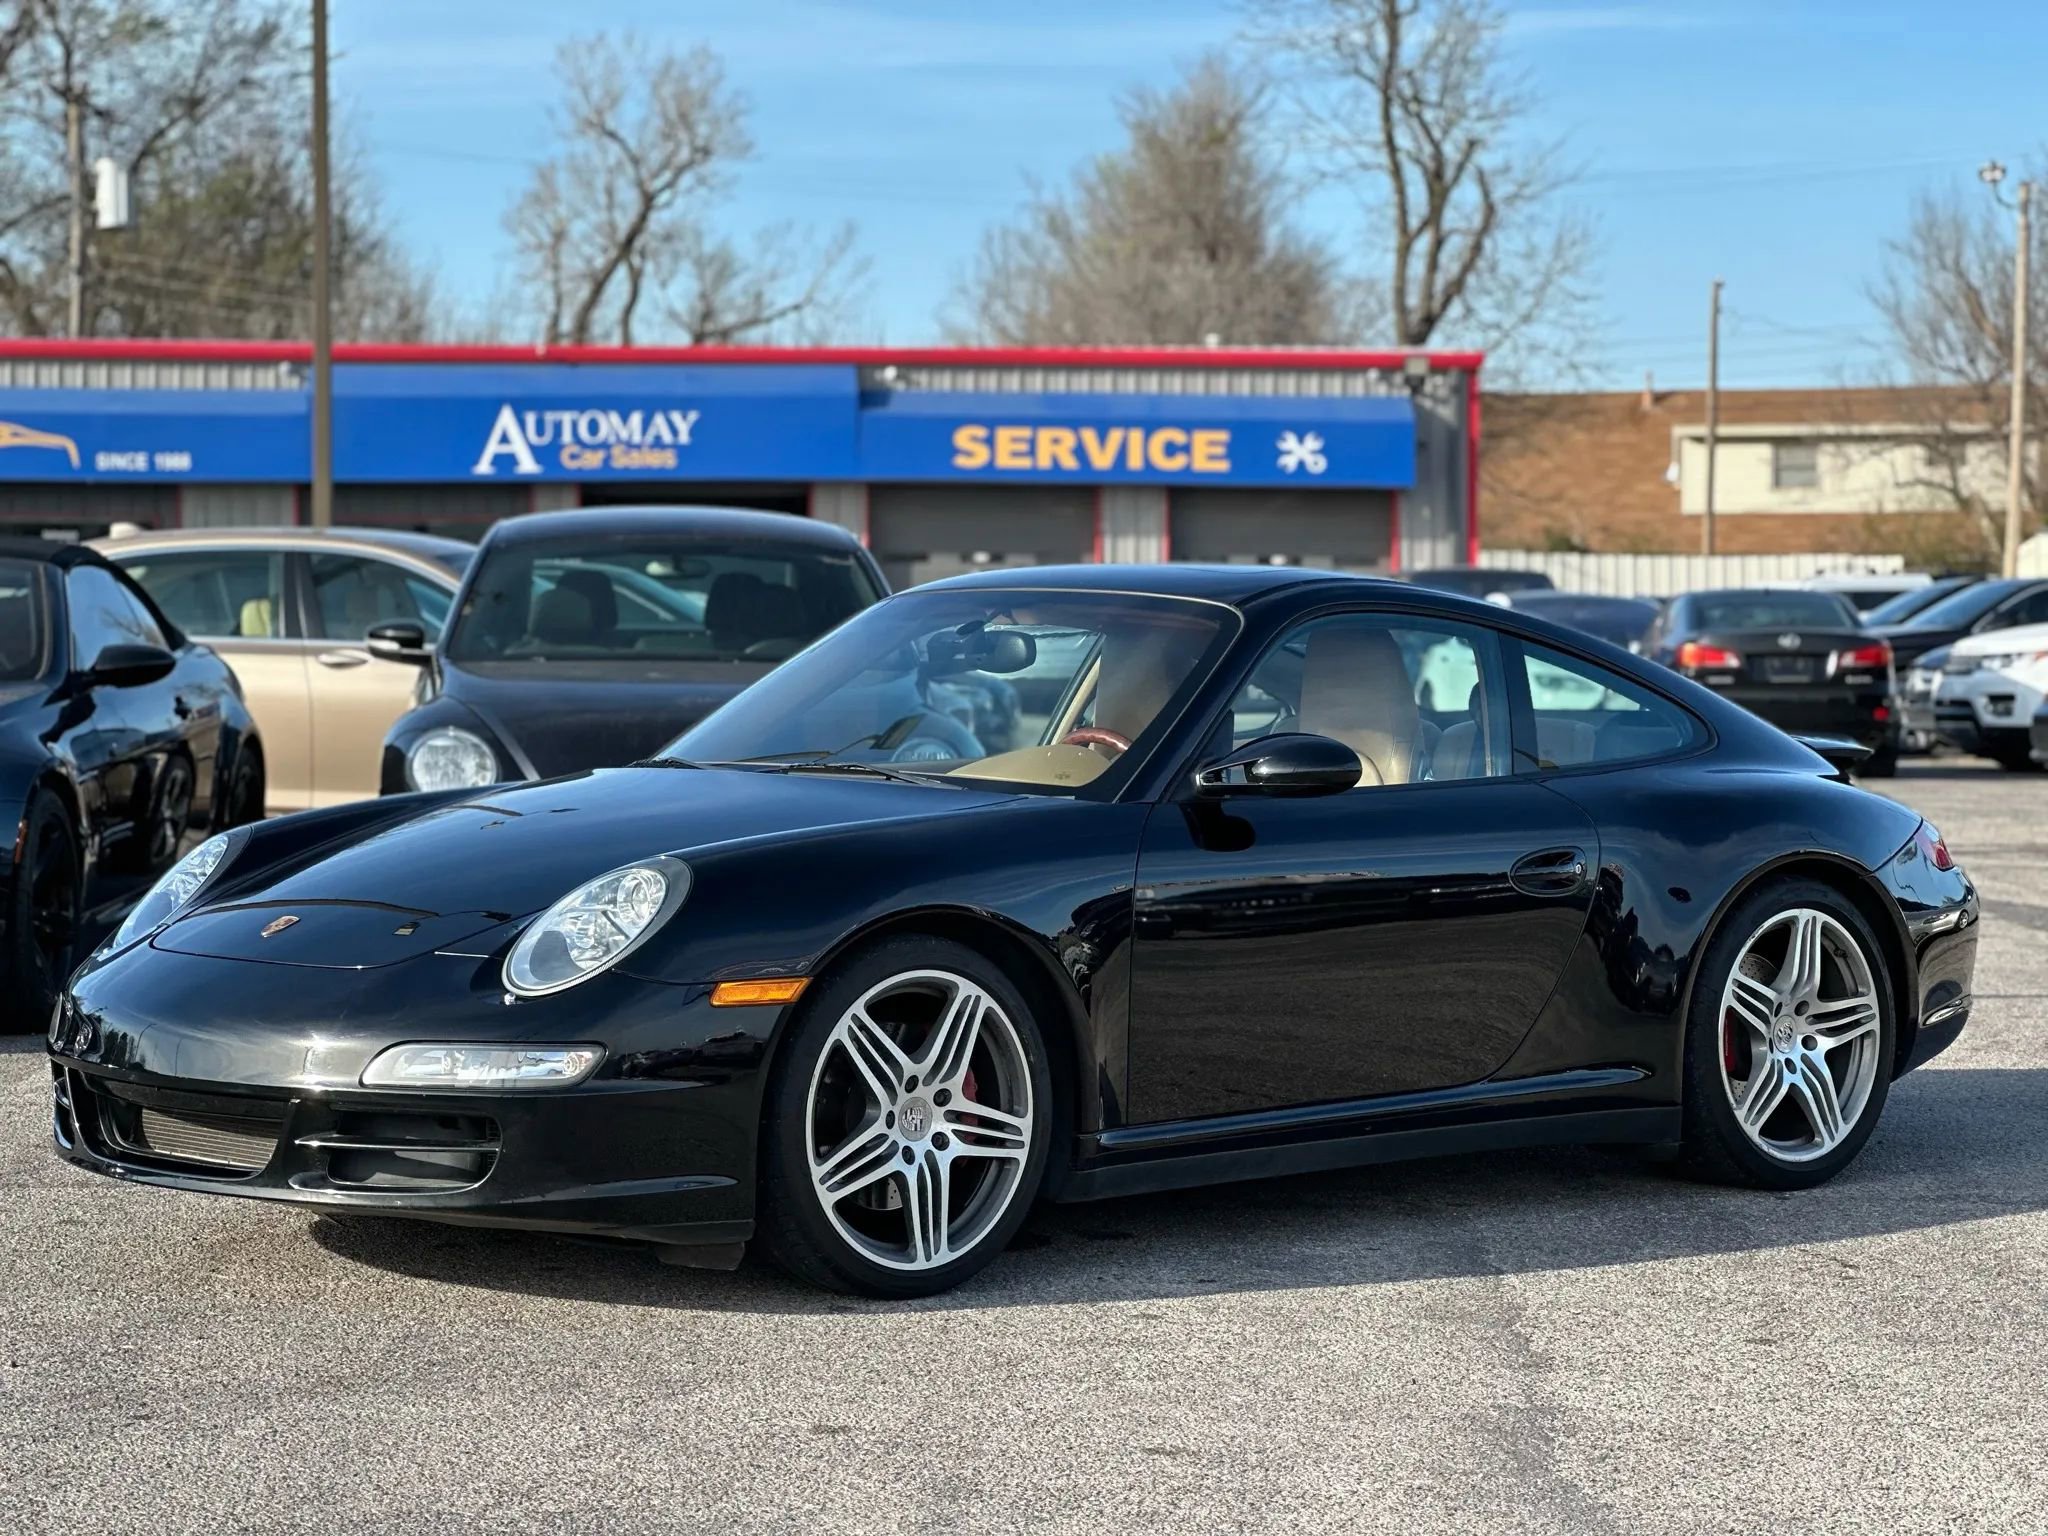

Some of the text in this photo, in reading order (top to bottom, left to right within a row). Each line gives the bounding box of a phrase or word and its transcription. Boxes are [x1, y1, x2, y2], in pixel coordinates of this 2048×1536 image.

[471, 403, 699, 474] AUTOMAY
[560, 444, 678, 469] Car Sales
[952, 425, 1232, 473] SERVICE
[95, 451, 149, 471] SINCE
